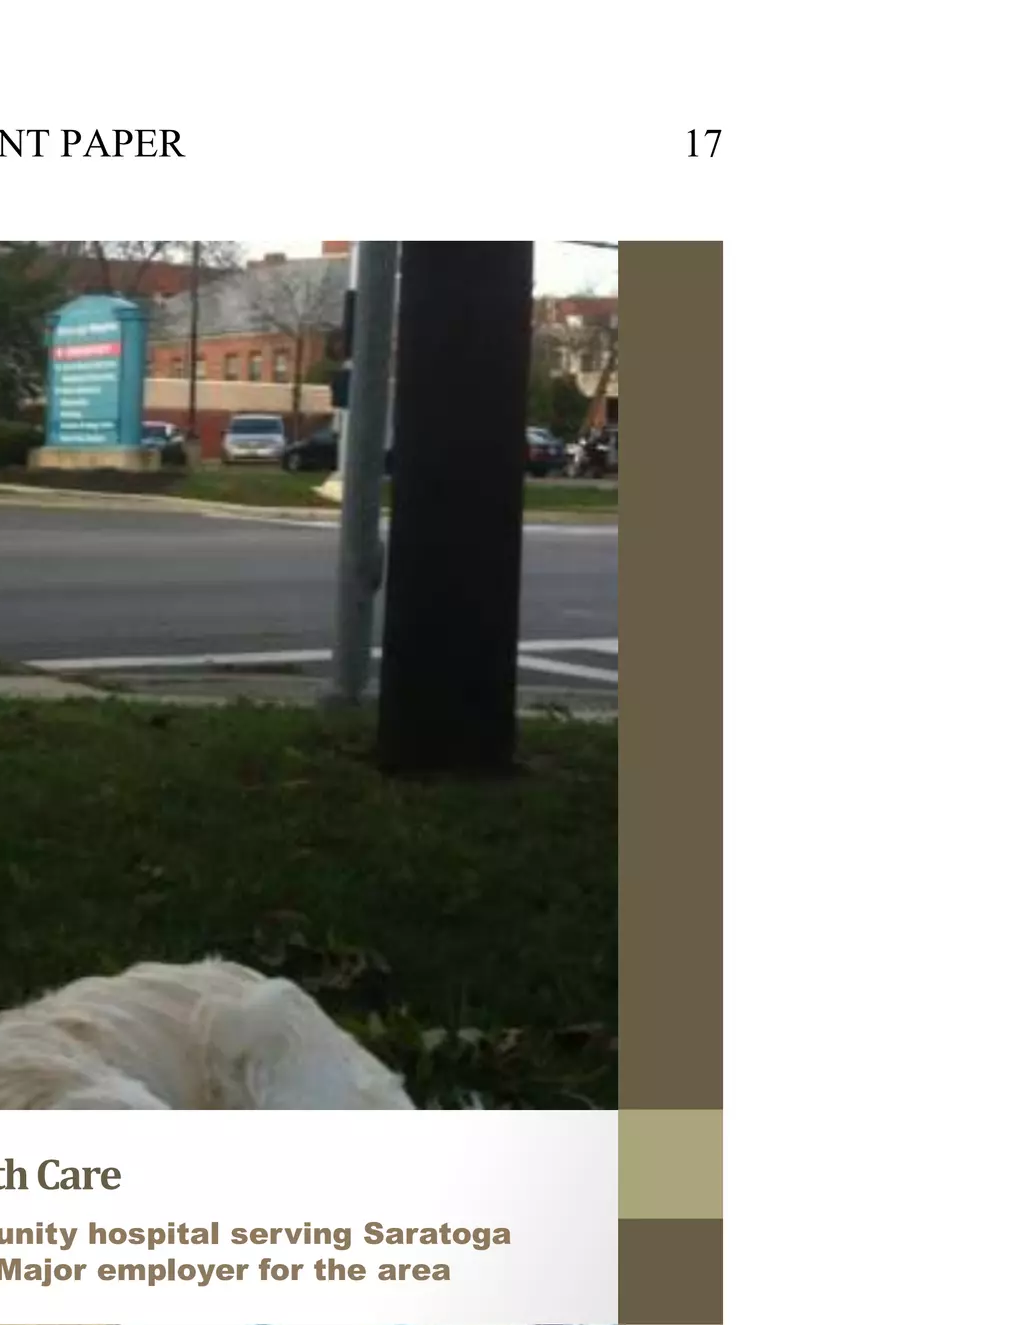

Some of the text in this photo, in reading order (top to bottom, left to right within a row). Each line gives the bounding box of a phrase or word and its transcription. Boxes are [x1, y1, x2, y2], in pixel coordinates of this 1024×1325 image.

[61, 129, 185, 157] PAPER
[688, 128, 722, 157] 17
[38, 1158, 121, 1191] Care
[89, 1222, 218, 1250] hospital
[231, 1222, 351, 1250] serving
[364, 1222, 510, 1250] Saratoga
[98, 1258, 249, 1286] employer
[259, 1258, 304, 1280] for
[314, 1258, 366, 1280] the
[378, 1264, 450, 1280] area
